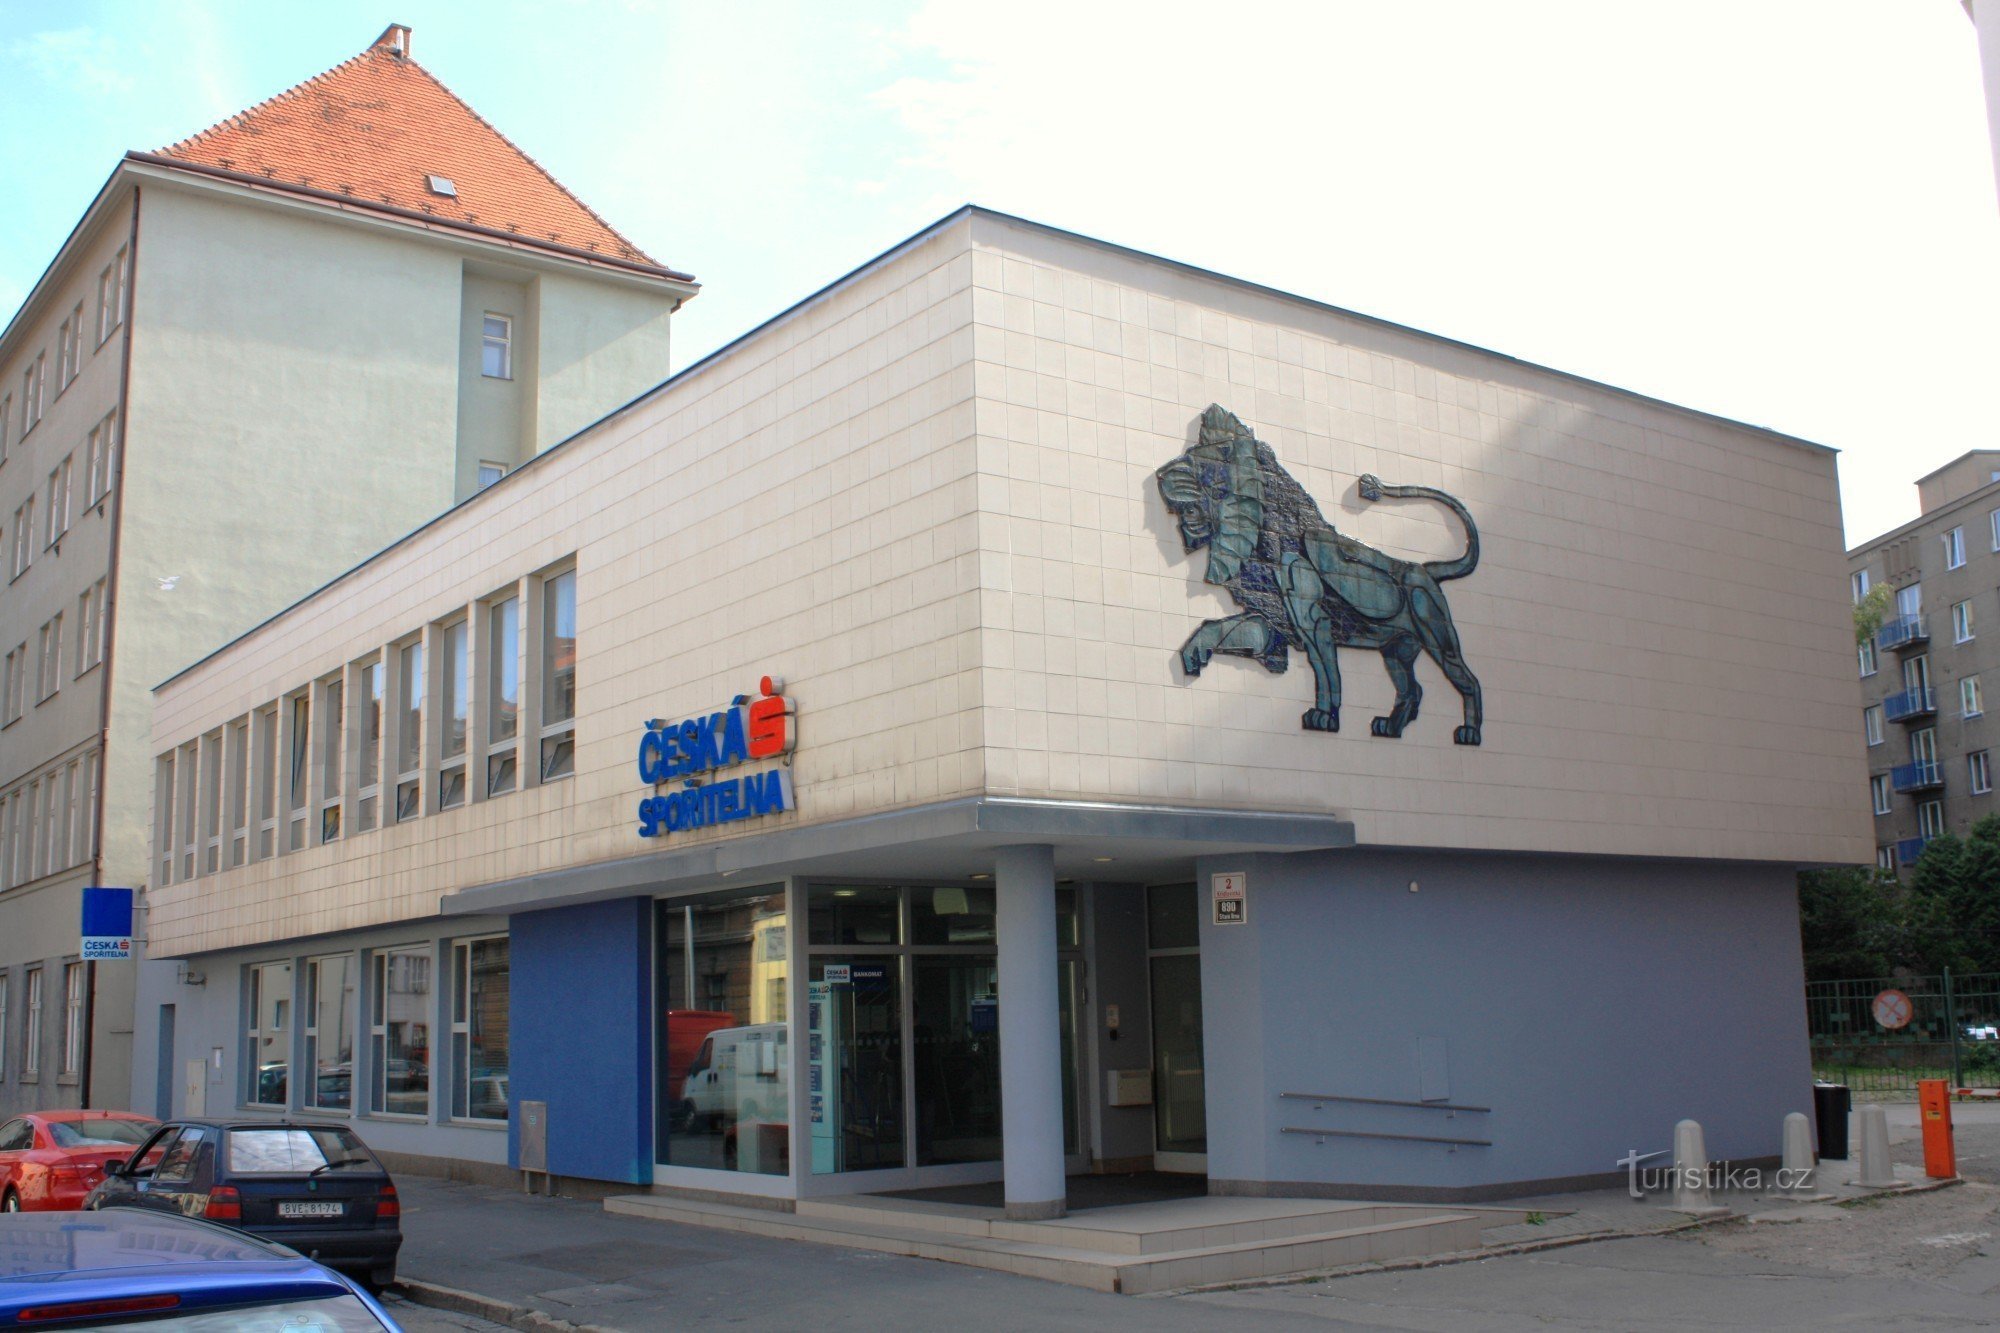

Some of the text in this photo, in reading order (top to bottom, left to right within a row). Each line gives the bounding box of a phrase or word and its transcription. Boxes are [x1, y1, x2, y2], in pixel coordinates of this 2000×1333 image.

[638, 694, 748, 785] ČESKÁ
[638, 769, 786, 838] SPOŘITELNA
[1225, 878, 1232, 890] 2
[1221, 901, 1236, 912] 890
[285, 1203, 304, 1214] BVE
